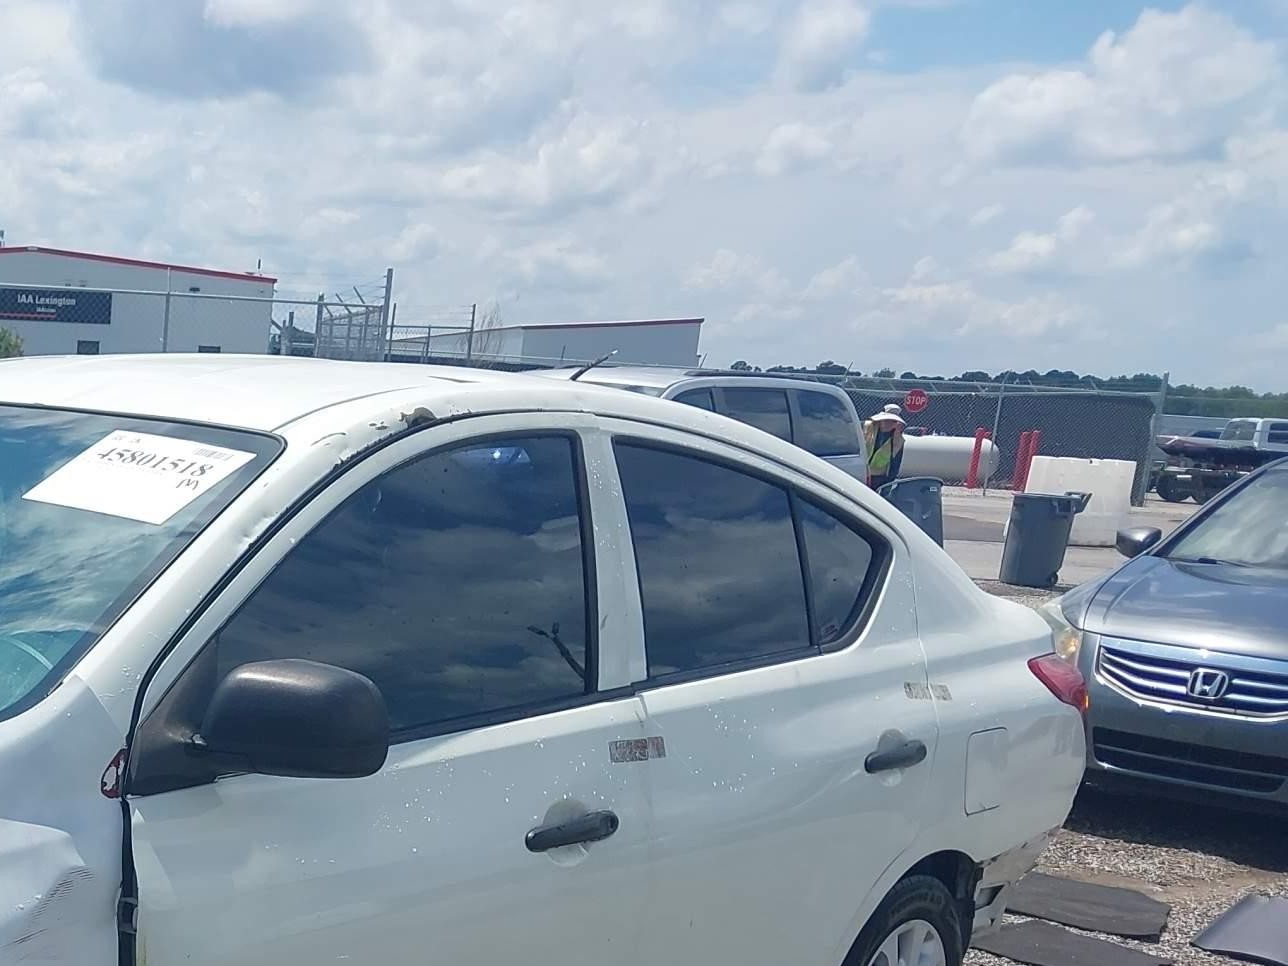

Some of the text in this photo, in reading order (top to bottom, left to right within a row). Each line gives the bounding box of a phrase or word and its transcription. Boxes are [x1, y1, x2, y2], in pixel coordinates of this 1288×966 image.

[17, 294, 76, 307] IAA Lexington
[906, 395, 926, 405] STOP
[98, 448, 214, 477] 45801518
